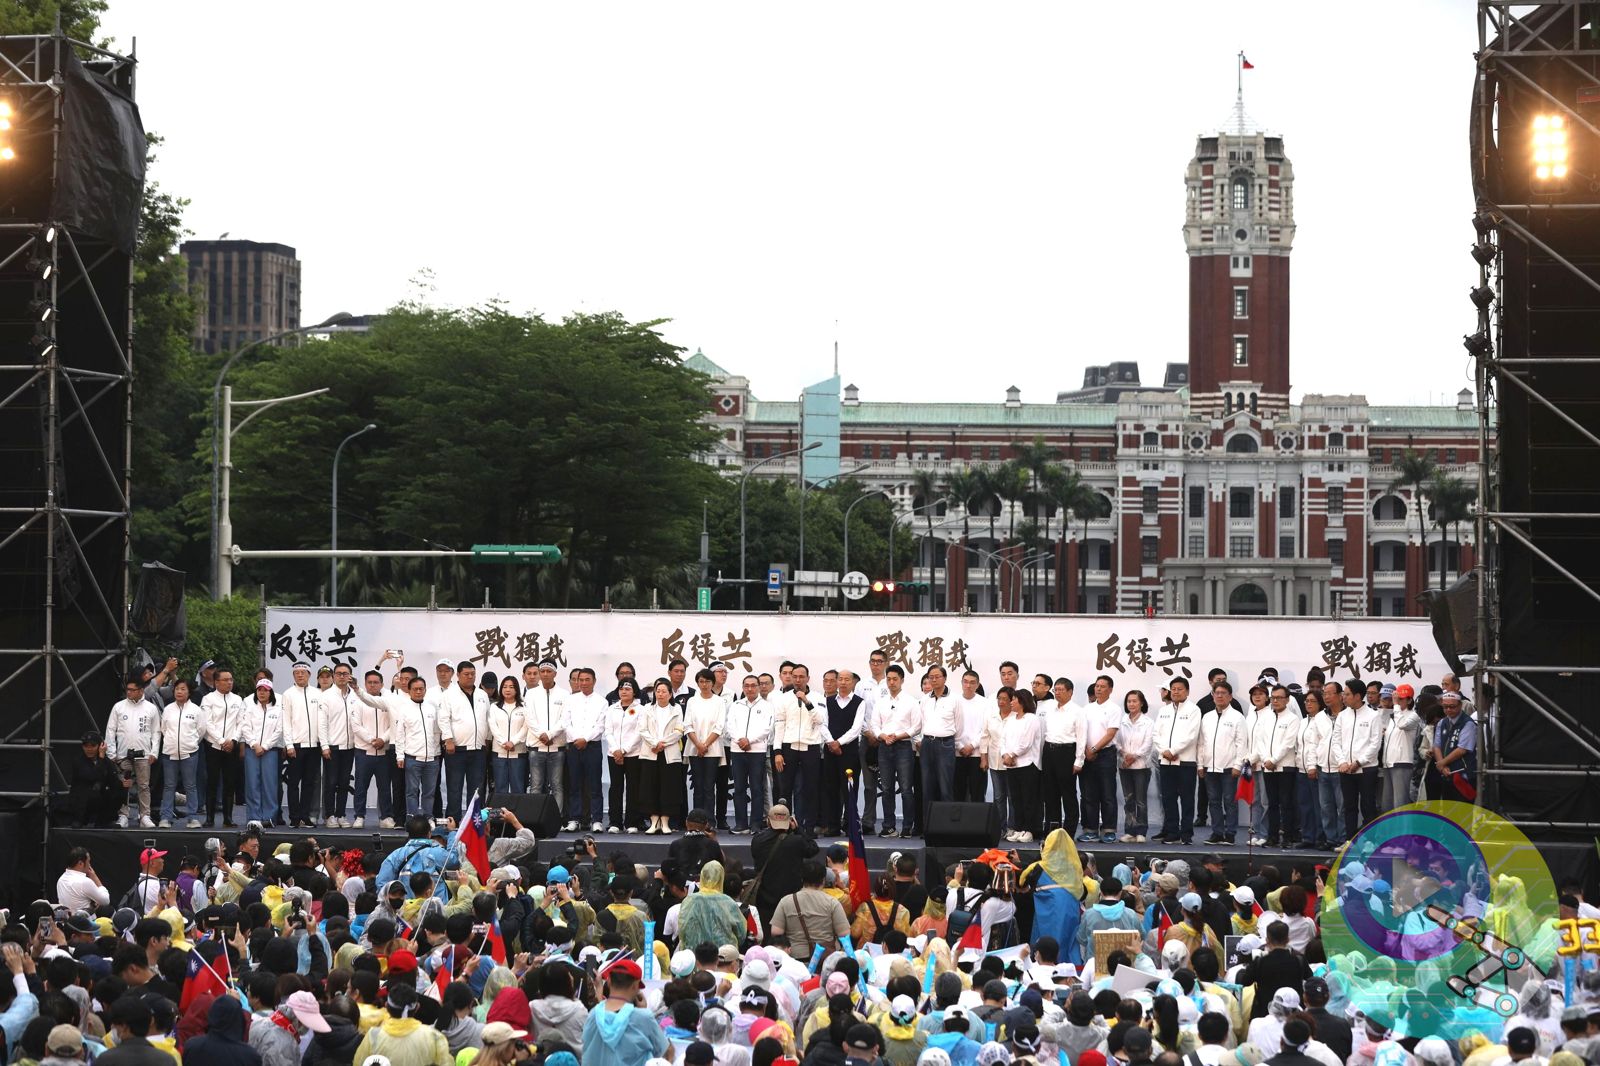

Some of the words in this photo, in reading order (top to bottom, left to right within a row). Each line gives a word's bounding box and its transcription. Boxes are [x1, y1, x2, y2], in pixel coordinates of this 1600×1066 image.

[270, 624, 358, 667] 反綠共
[469, 626, 568, 669] 戰獨裁
[661, 628, 753, 672] 反綠共
[876, 630, 972, 674] 戰獨裁
[1096, 633, 1192, 678] 反綠共
[1320, 635, 1422, 679] 戰獨裁
